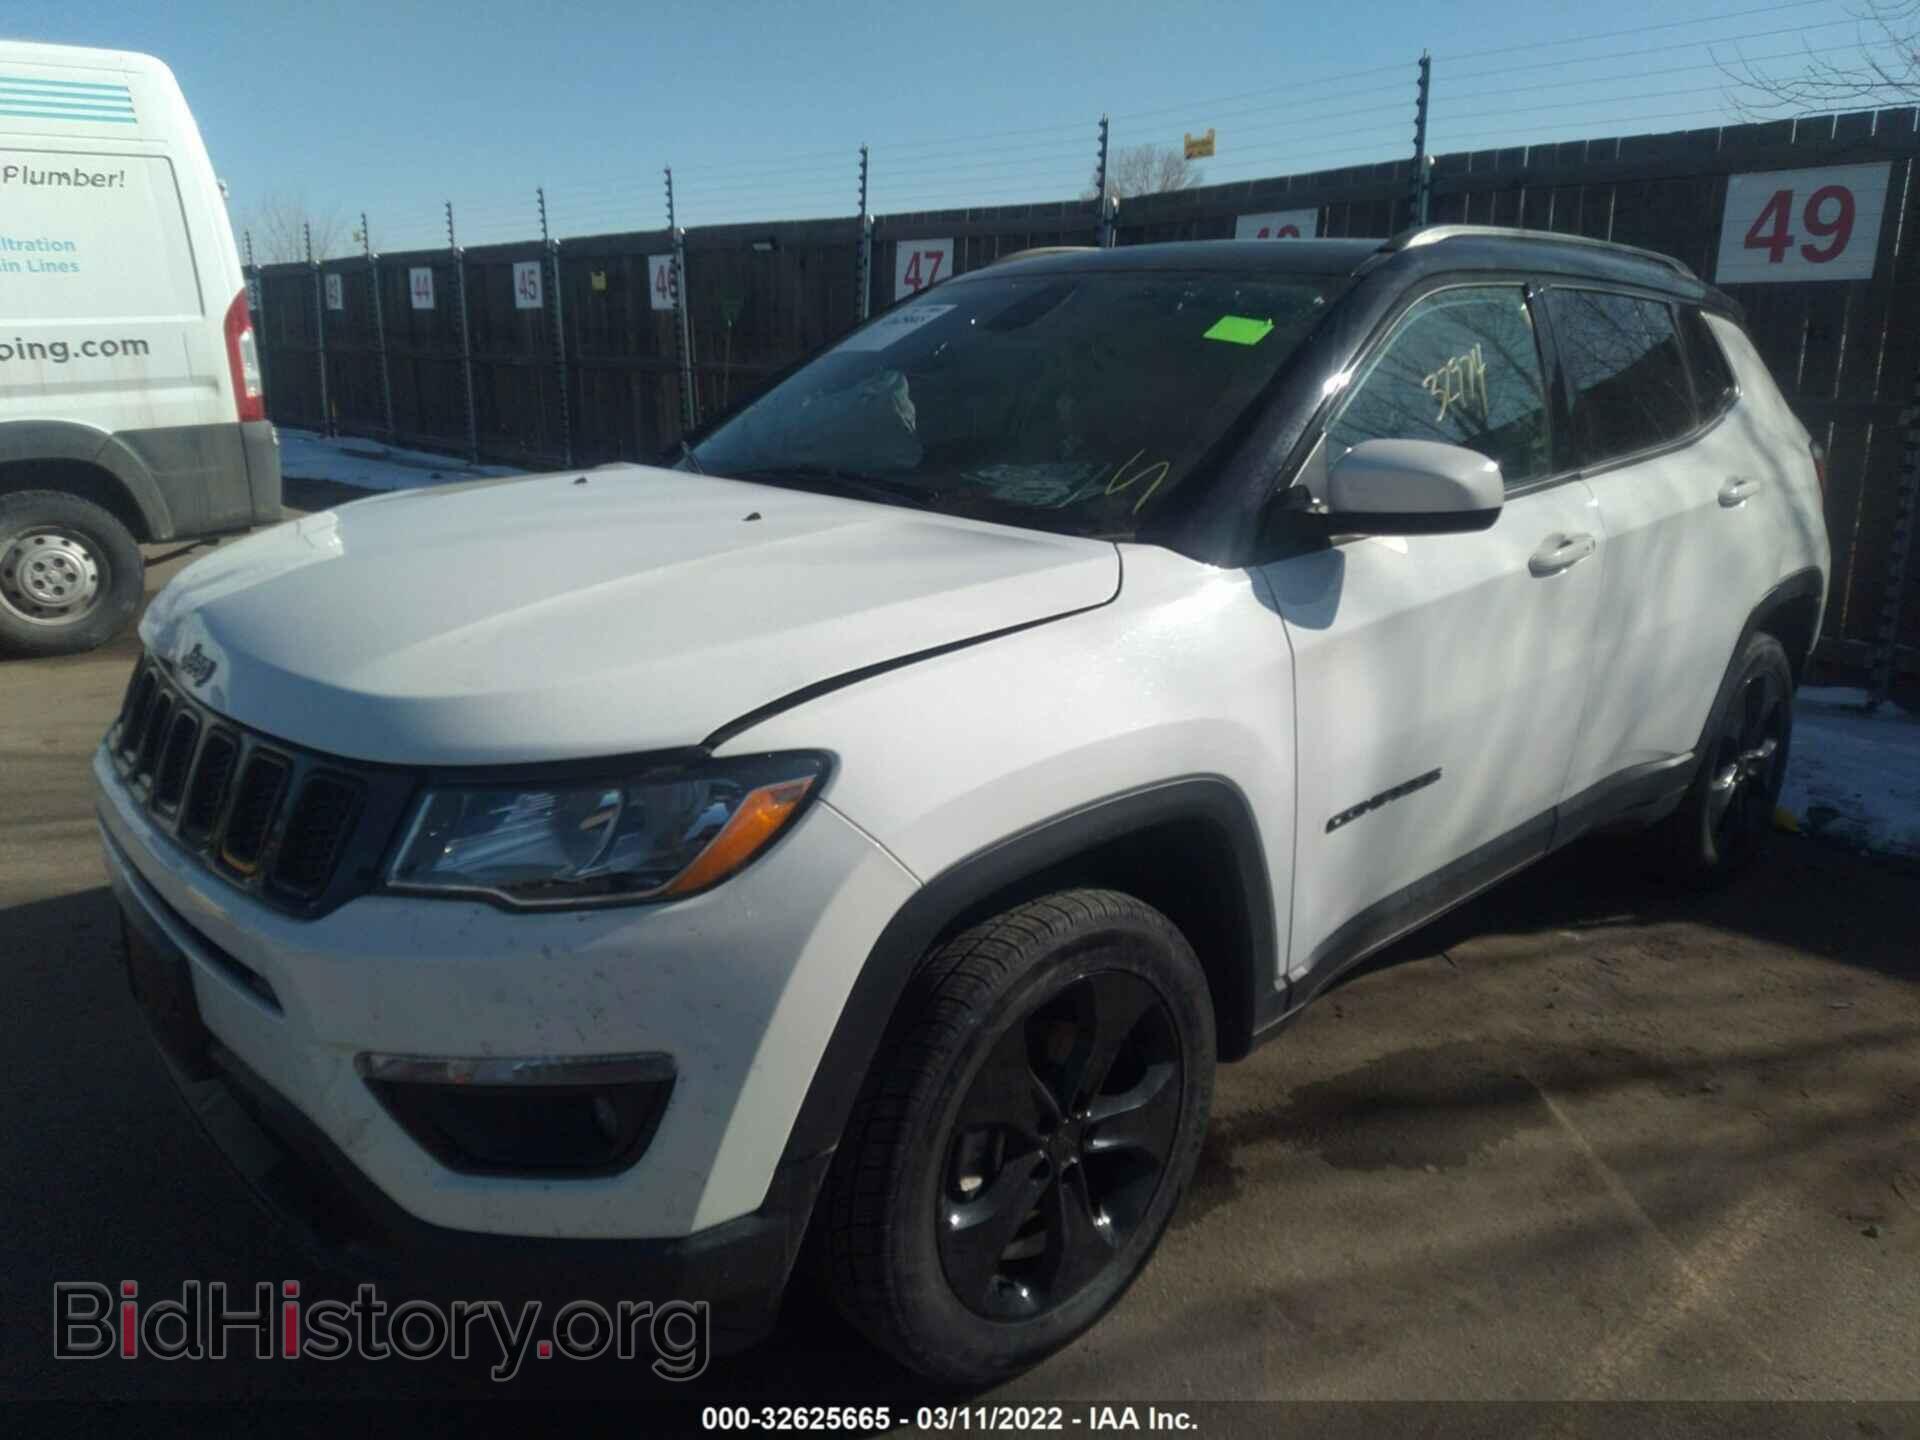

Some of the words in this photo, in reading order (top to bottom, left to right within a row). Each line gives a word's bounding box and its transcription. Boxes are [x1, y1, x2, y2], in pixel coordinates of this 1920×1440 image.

[3, 164, 126, 189] Plumber!
[1743, 184, 1856, 264] 49
[27, 258, 80, 273] Lines
[903, 249, 945, 294] 47
[518, 268, 538, 300] 45
